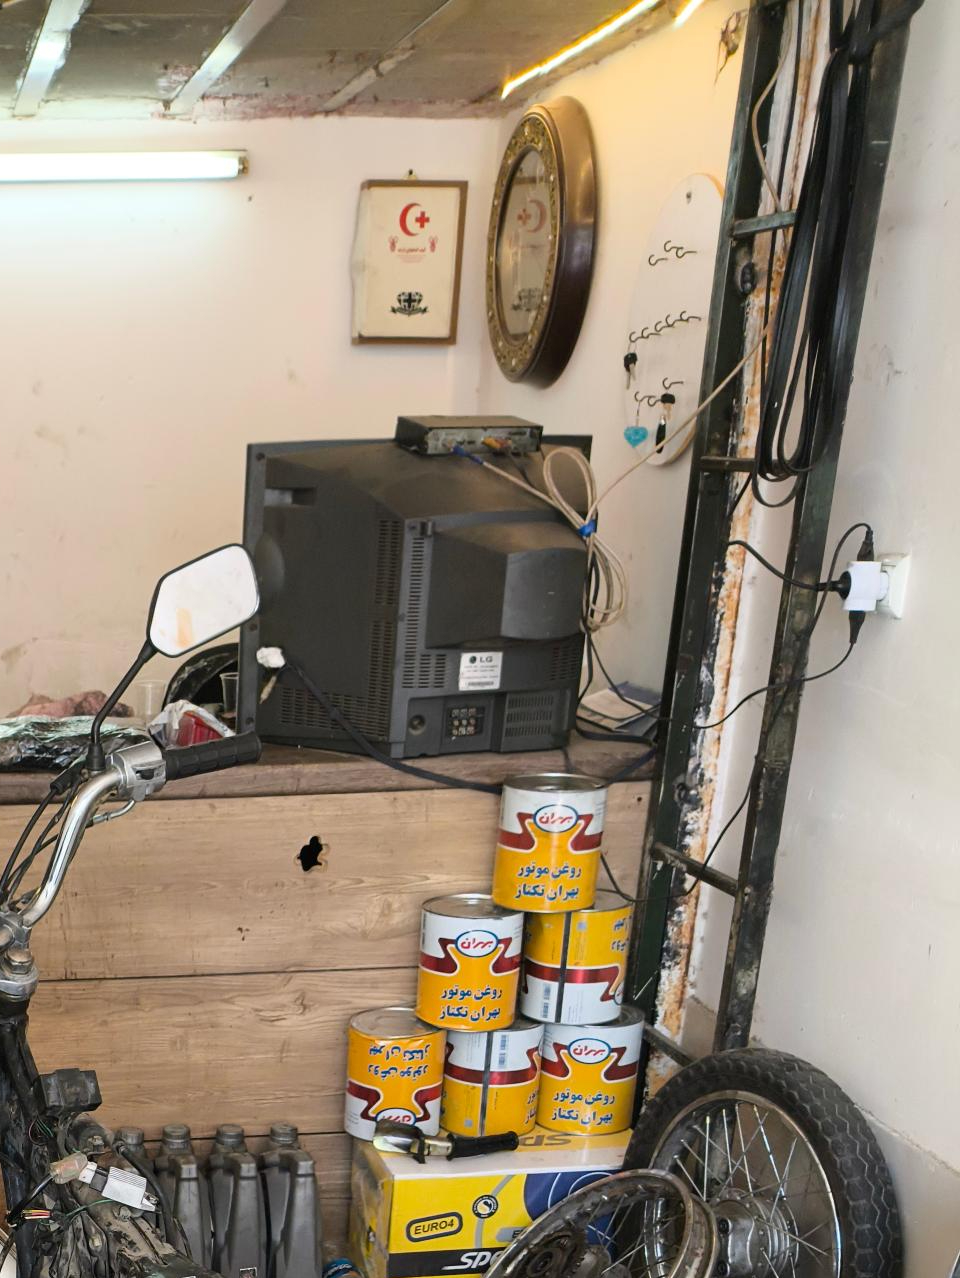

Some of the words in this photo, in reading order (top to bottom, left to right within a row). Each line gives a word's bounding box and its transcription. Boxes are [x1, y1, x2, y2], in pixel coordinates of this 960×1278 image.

[480, 655, 493, 663] LG
[518, 861, 549, 879] موتور
[551, 862, 582, 879] روغن
[515, 883, 545, 898] تکتاز
[546, 885, 579, 901] بهران
[441, 985, 472, 1000] موتور
[473, 985, 502, 1000] روغن
[440, 1005, 468, 1019] تکتاز
[470, 1006, 501, 1021] بهران
[553, 1089, 583, 1104] موتور
[584, 1090, 615, 1105] روغن
[552, 1108, 579, 1120] تکتاز
[580, 1112, 613, 1125] بهران
[414, 1219, 455, 1235] EURO4
